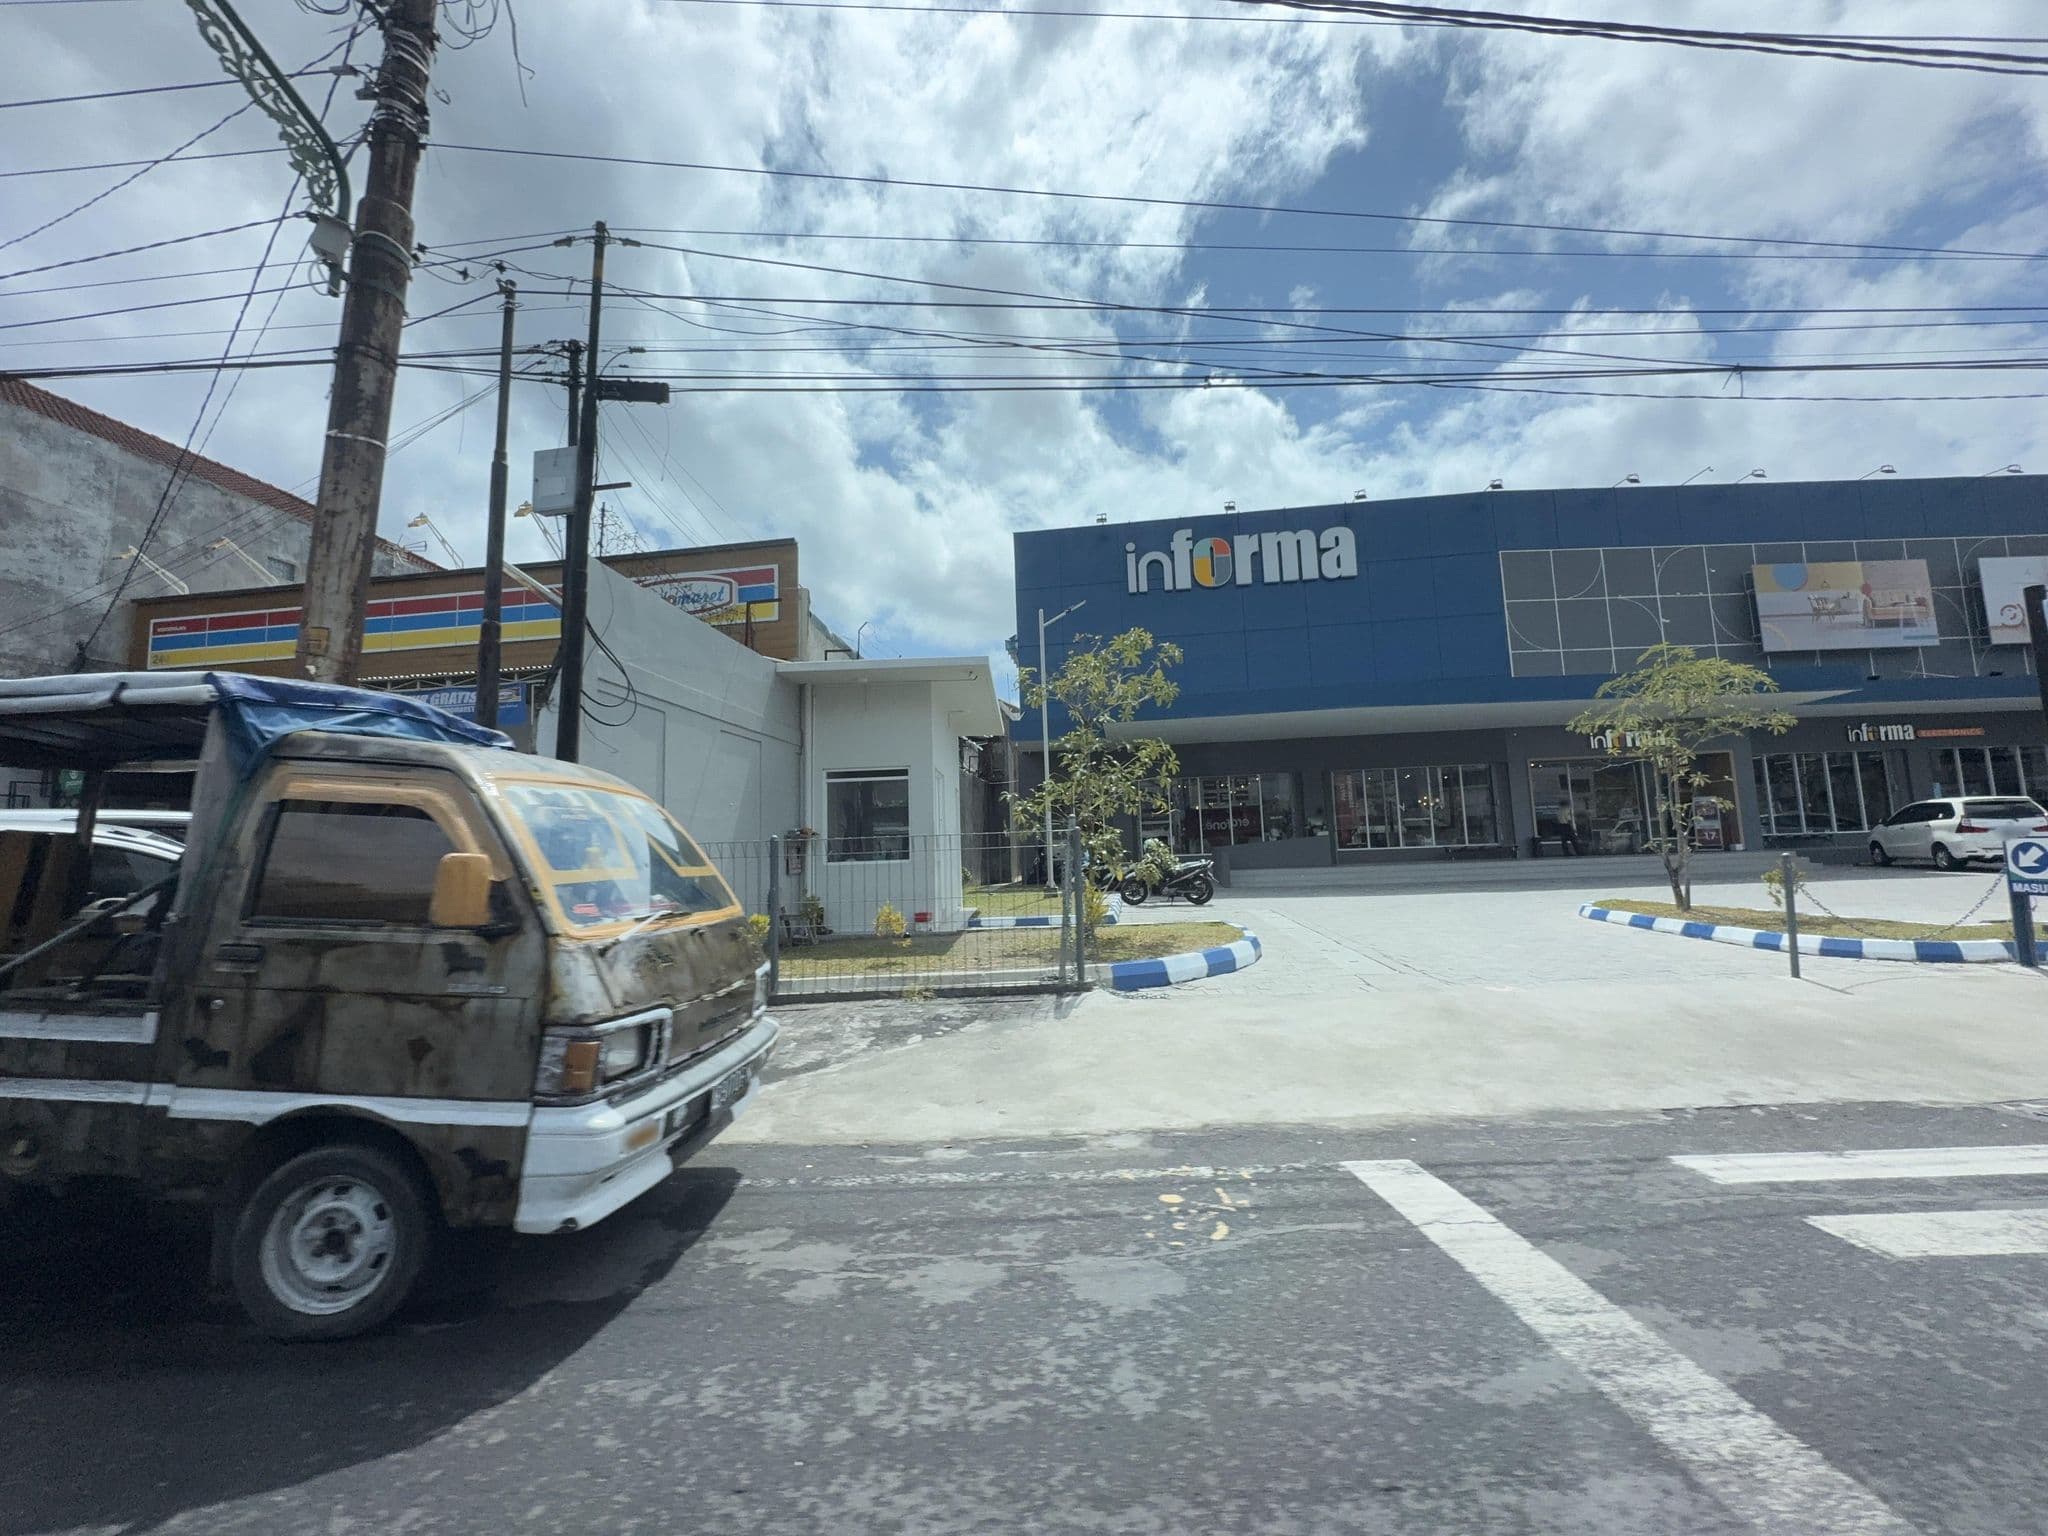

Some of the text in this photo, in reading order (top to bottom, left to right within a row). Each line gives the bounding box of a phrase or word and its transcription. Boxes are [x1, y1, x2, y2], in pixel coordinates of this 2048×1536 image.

[1125, 526, 1358, 594] informa
[1847, 723, 1915, 742] informa
[2012, 883, 2048, 894] MASU
